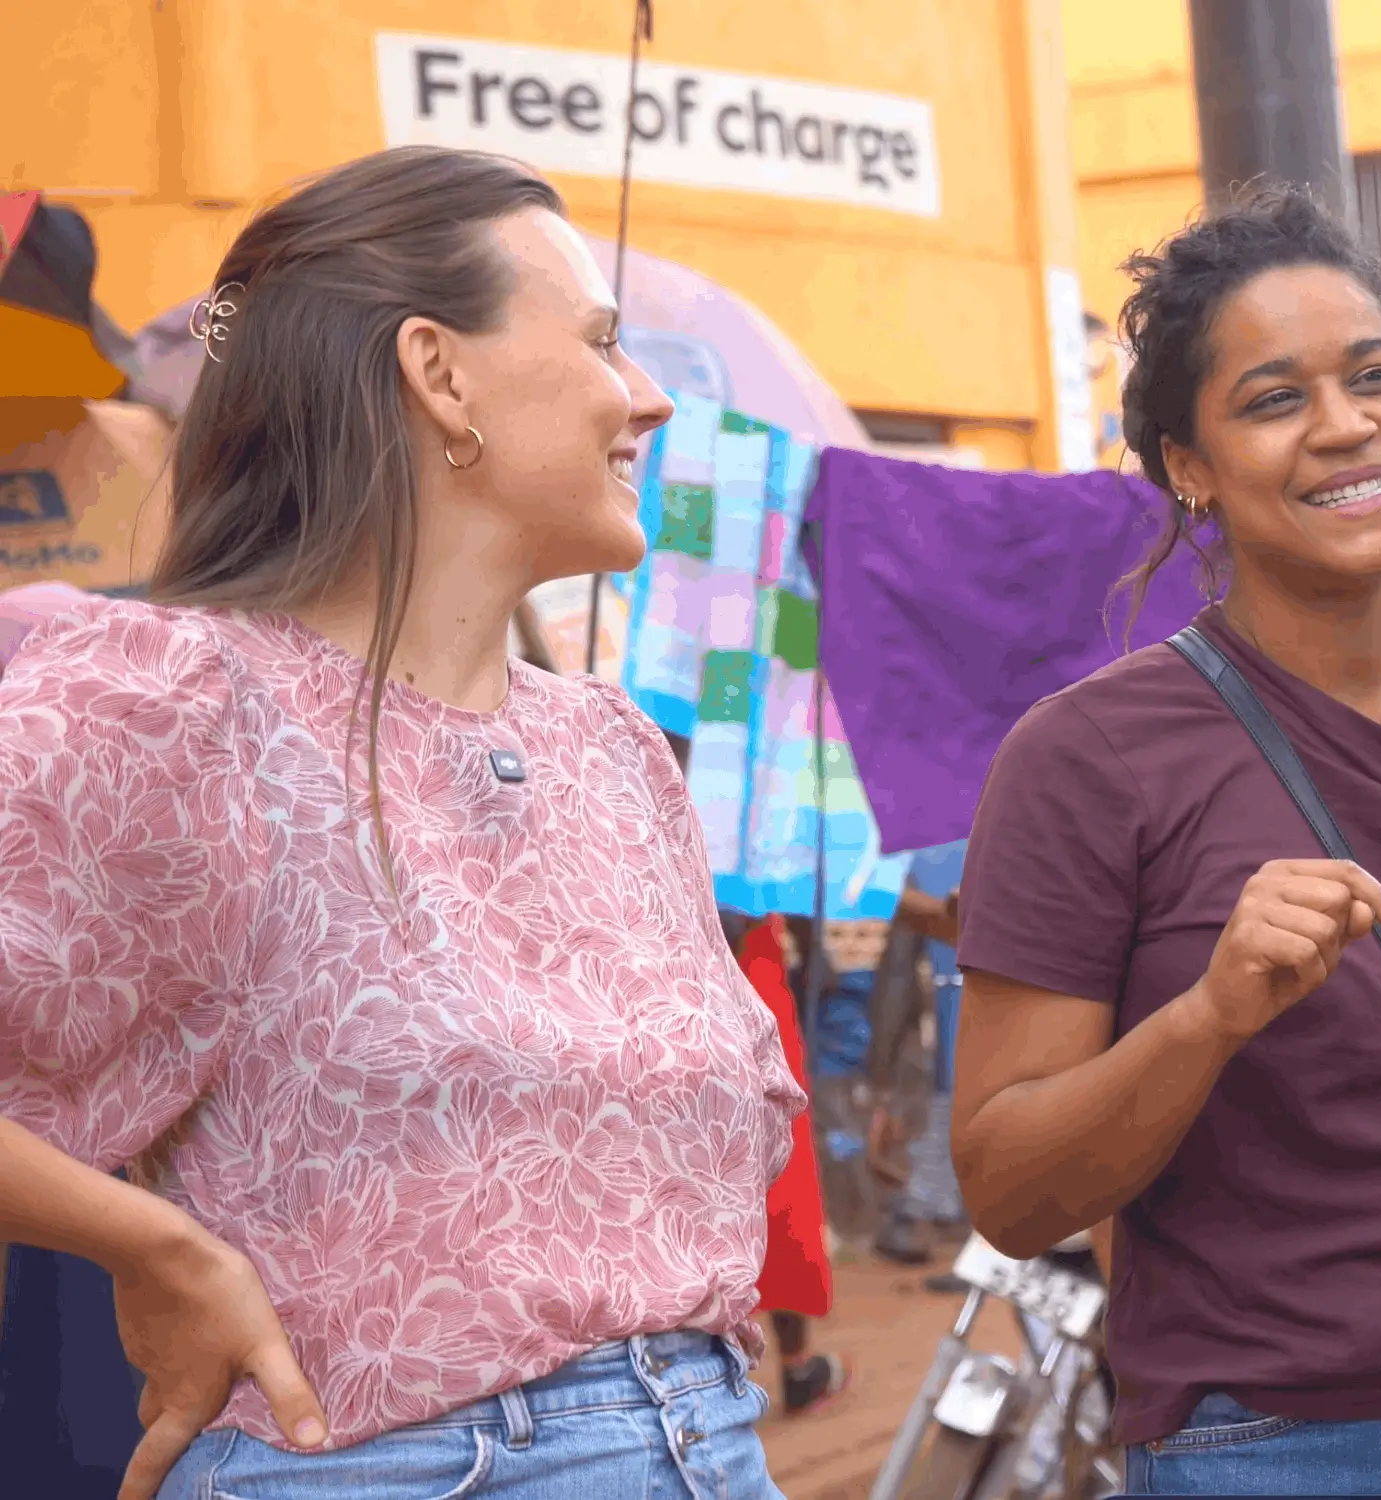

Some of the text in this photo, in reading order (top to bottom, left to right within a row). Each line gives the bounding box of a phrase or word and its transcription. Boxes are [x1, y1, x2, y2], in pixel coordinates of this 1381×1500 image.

[413, 48, 920, 190] Free of charge
